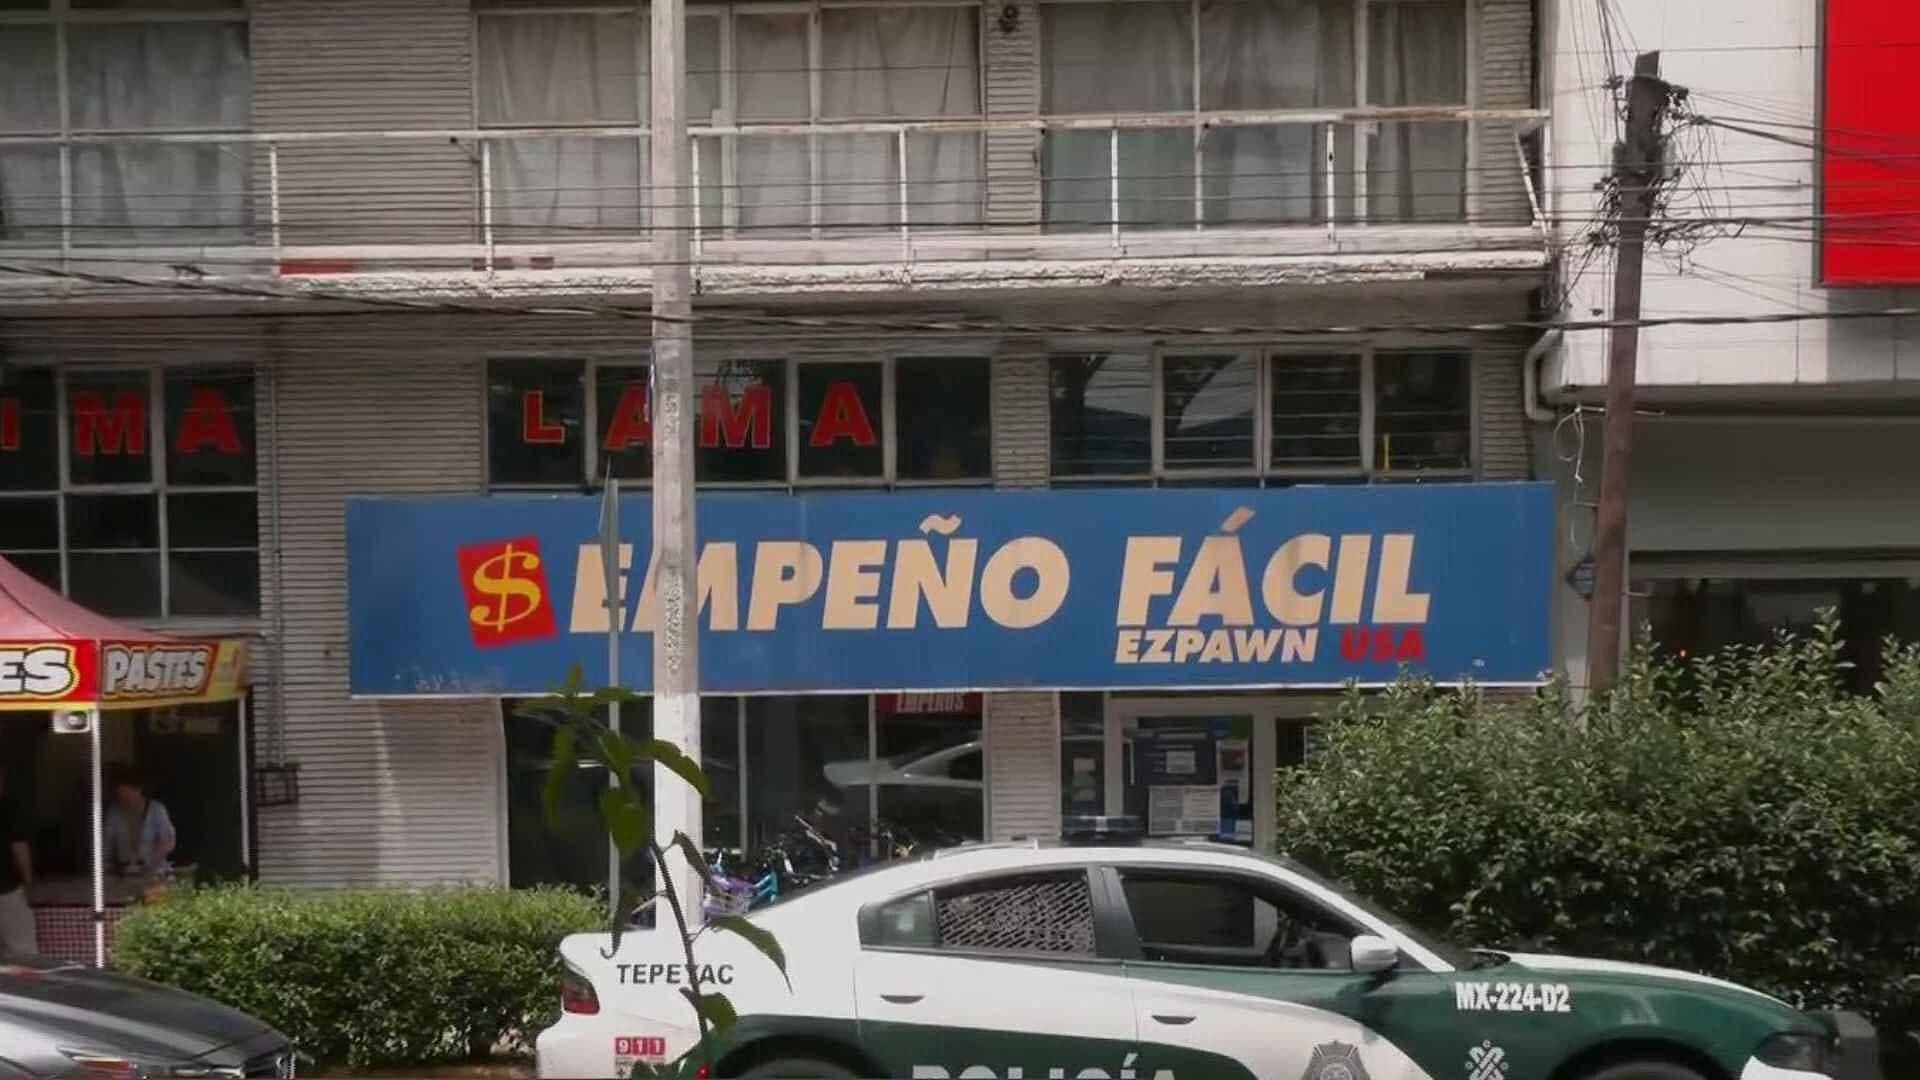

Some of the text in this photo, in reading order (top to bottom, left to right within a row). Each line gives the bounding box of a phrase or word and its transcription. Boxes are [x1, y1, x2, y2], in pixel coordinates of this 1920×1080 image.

[523, 381, 876, 449] LAMA
[569, 514, 1070, 631] EMPEÑO
[1116, 506, 1430, 626] FÁCIL
[1115, 627, 1425, 663] EZPAWN USA
[103, 650, 209, 694] PASTES
[1455, 981, 1570, 1012] MX-224-D2
[618, 1040, 662, 1055] 911
